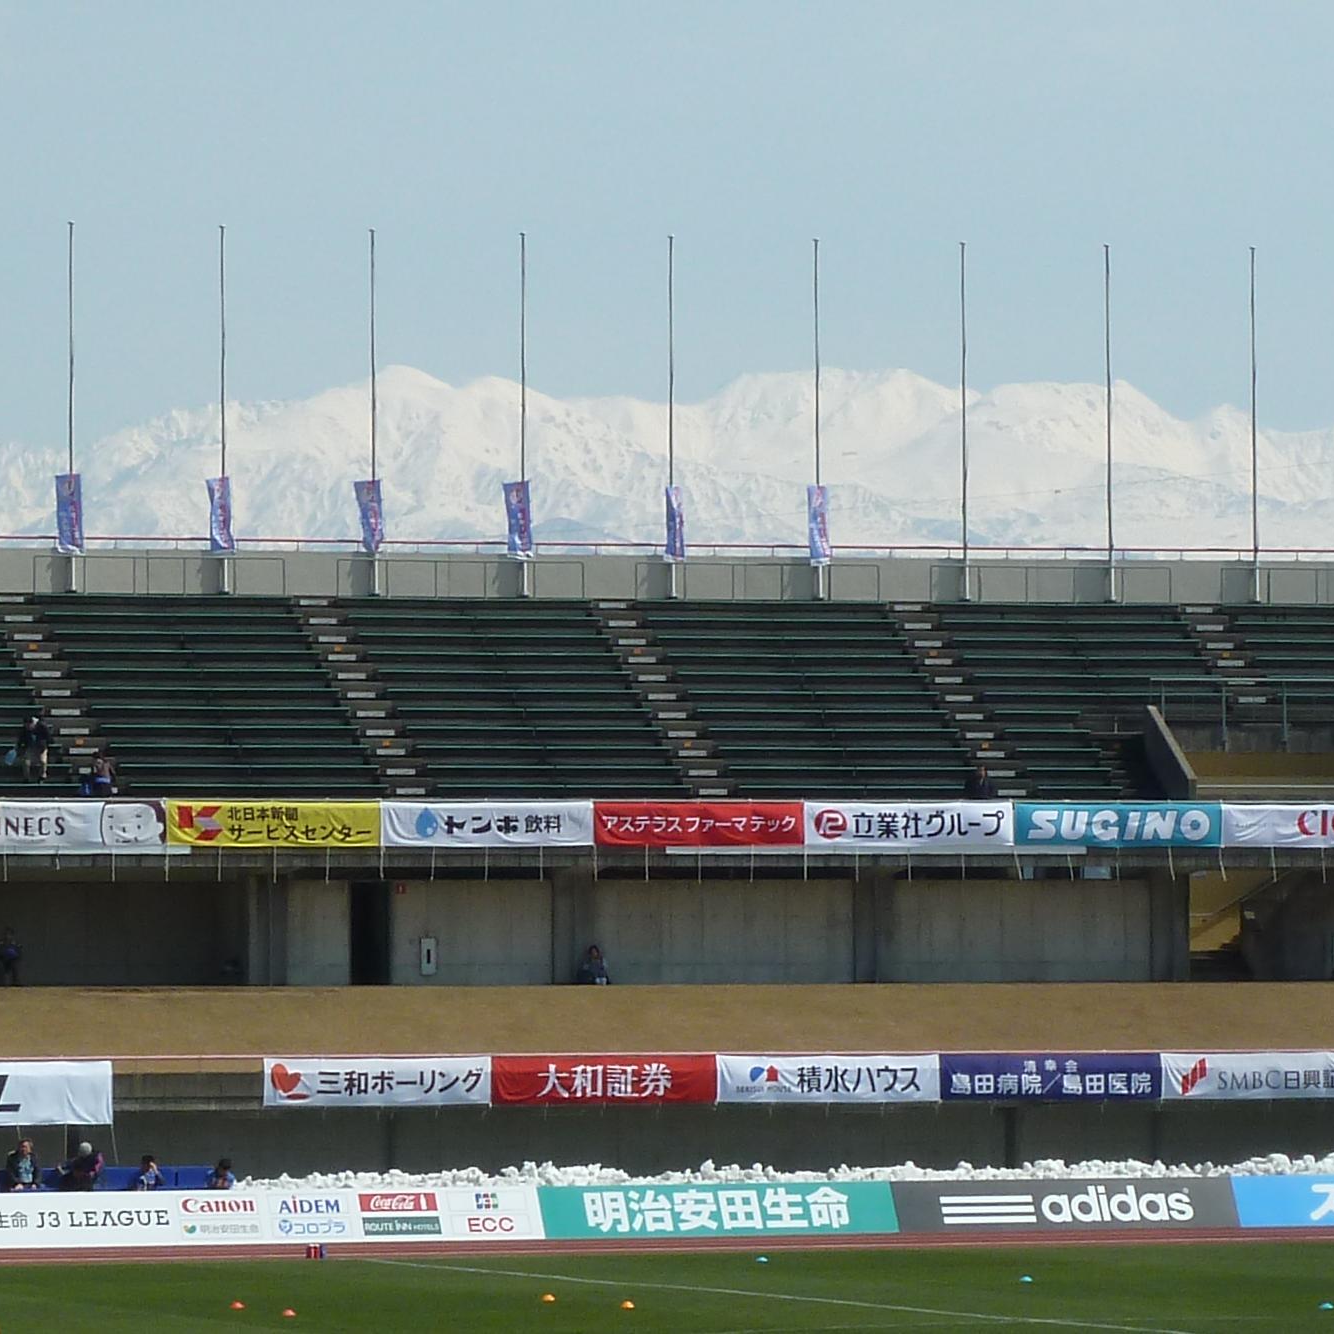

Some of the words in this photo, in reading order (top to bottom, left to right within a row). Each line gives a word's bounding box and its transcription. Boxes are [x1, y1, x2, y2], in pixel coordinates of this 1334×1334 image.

[227, 806, 298, 821] 北日本新聞
[1027, 809, 1211, 840] SUGINO
[229, 824, 372, 842] サービスセンター
[316, 1067, 484, 1096] 三和ボーリング
[536, 1063, 673, 1098] 大和証券
[797, 1065, 921, 1094] 積水ハウス
[36, 1211, 61, 1229] J3
[69, 1209, 170, 1227] LEAGUE
[181, 1198, 255, 1214] Canon
[583, 1186, 850, 1232] 明治安田生命
[1041, 1187, 1195, 1223] adidas
[468, 1217, 515, 1233] ECC
